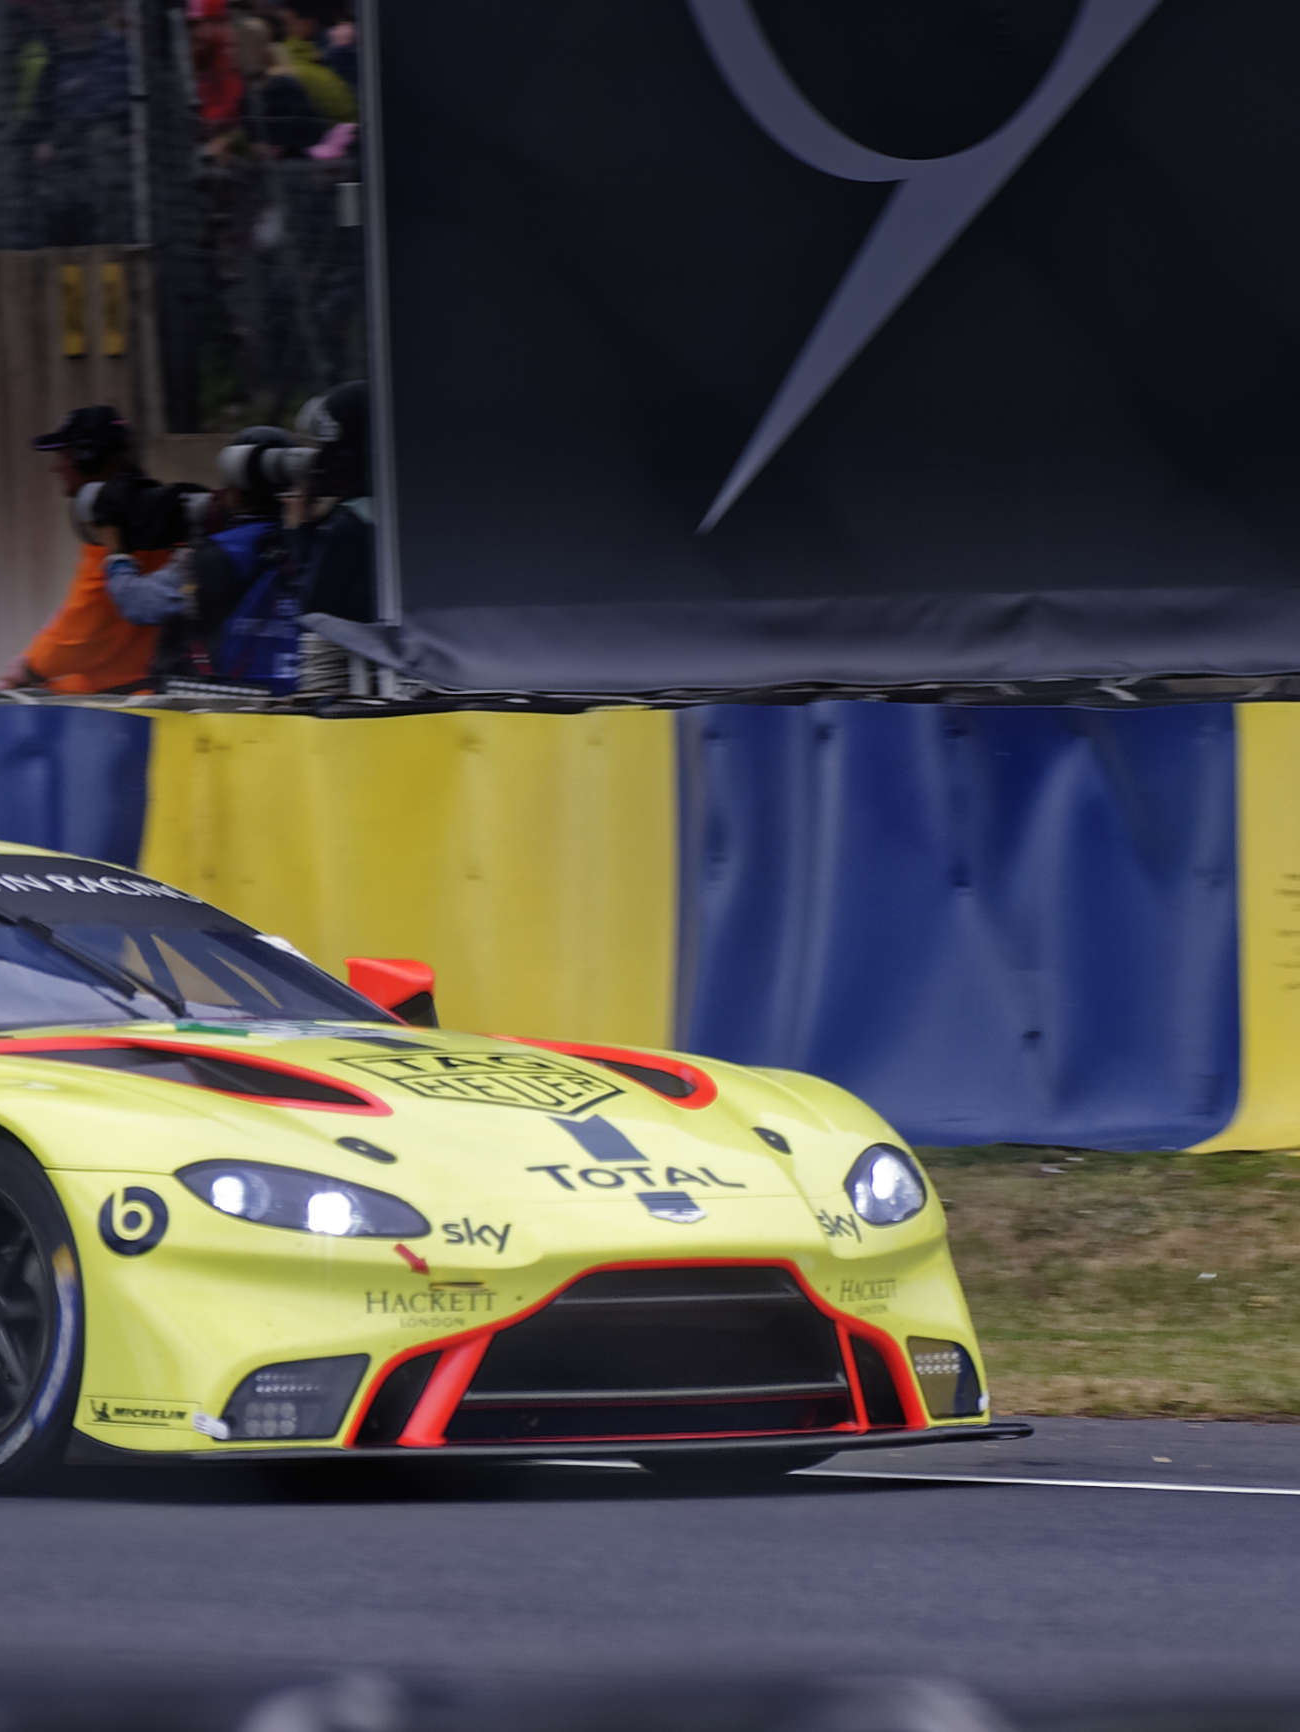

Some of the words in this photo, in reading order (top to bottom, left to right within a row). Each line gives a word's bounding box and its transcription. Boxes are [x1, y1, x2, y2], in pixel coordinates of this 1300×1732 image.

[363, 1056, 557, 1072] TAG
[413, 1075, 605, 1107] HEUER
[526, 1163, 747, 1191] TOTAL
[442, 1217, 512, 1254] sky
[840, 1278, 897, 1302] HACKETT
[365, 1290, 498, 1315] HACKETT
[400, 1317, 465, 1329] LONDON
[114, 1406, 188, 1420] MICHELIN
